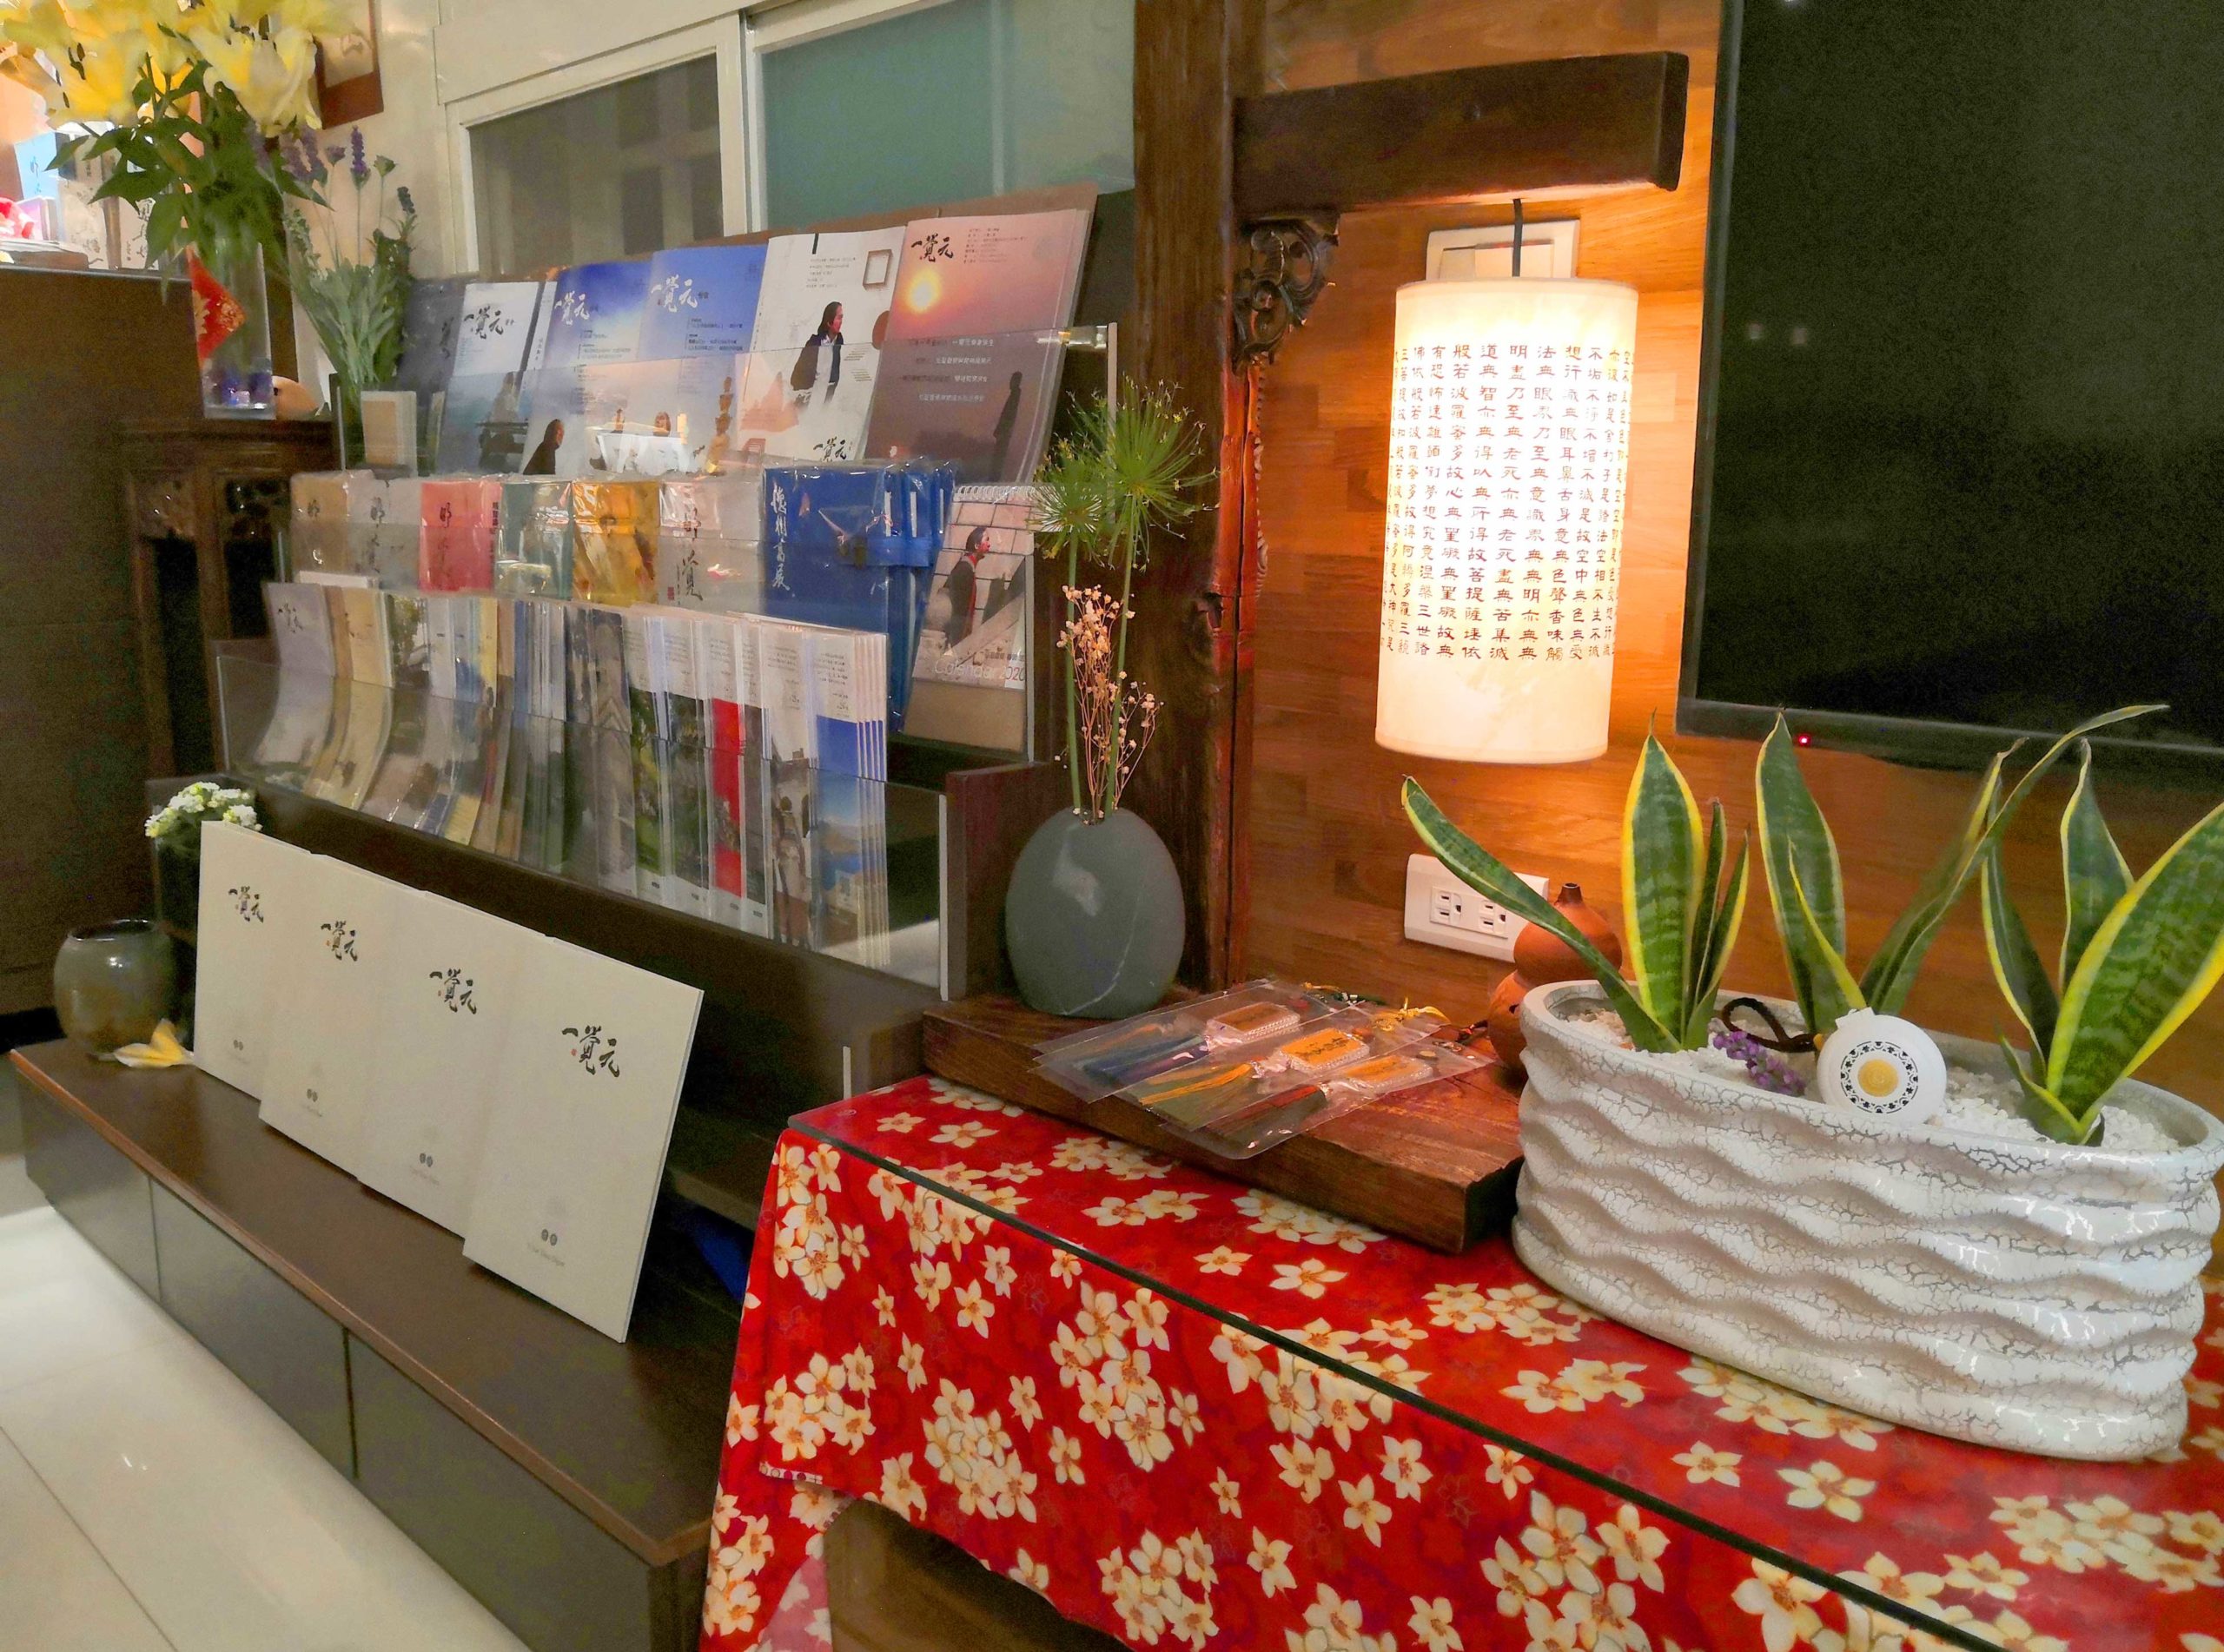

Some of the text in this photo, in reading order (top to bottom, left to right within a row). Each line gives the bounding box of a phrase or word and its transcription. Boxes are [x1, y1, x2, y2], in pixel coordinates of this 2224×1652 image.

[429, 968, 477, 1014] 一覺元
[561, 1025, 620, 1078] 一覺元
